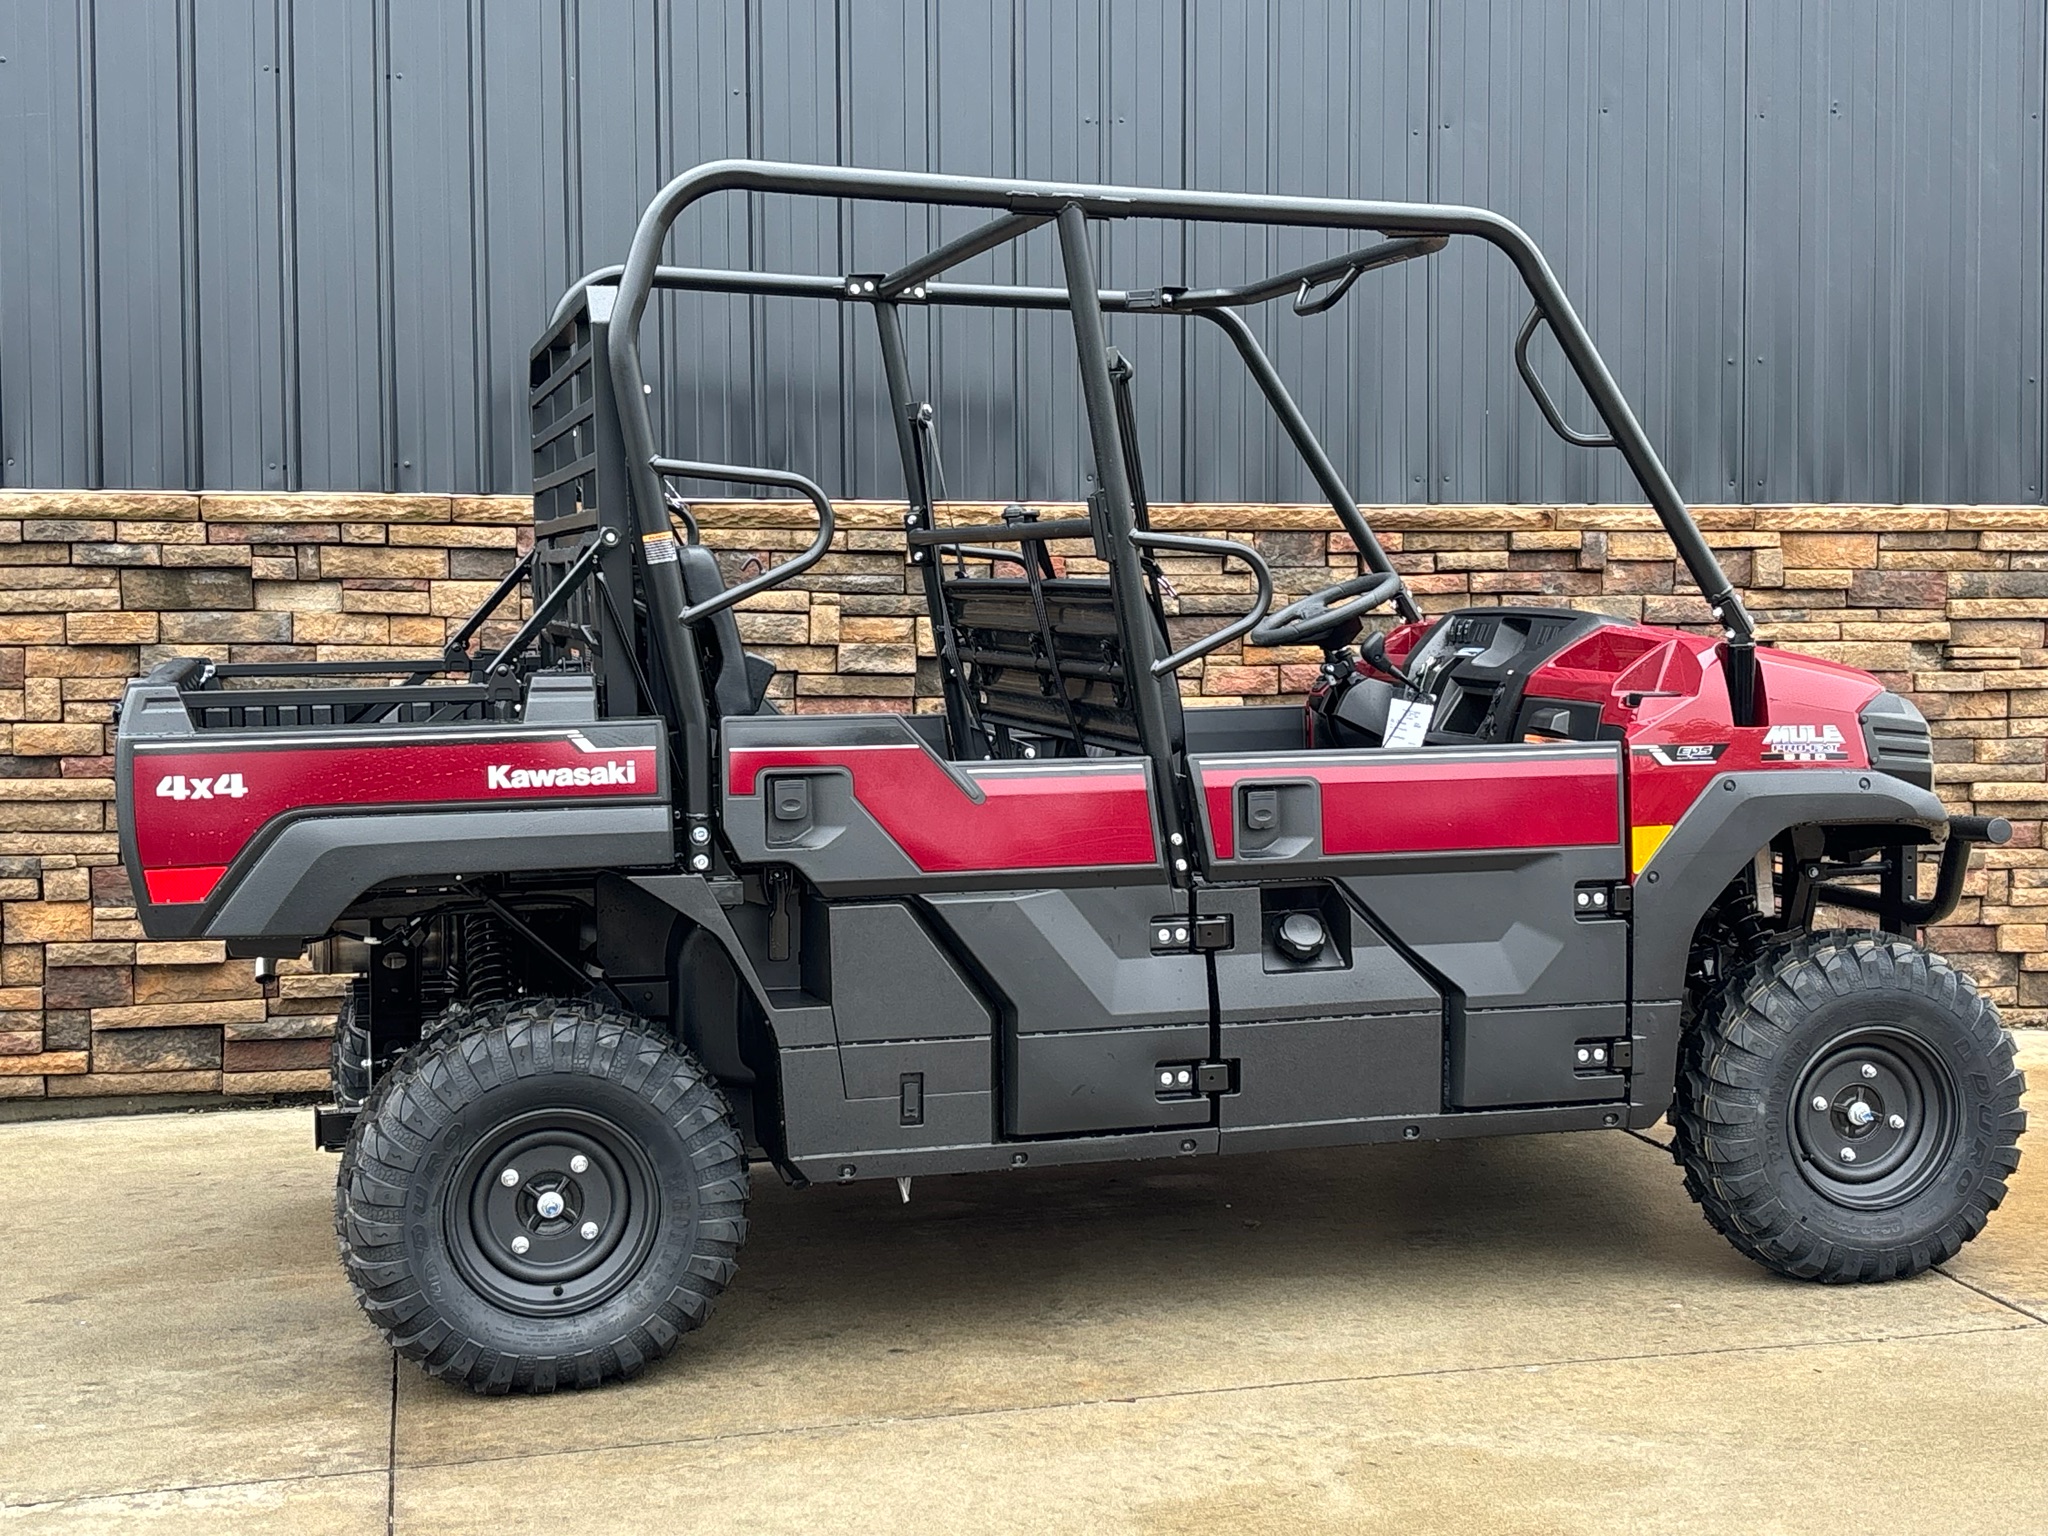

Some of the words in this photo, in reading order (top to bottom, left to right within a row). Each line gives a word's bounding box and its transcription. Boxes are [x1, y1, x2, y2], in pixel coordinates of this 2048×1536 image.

[1761, 725, 1847, 744] MULE
[155, 772, 249, 801] 4x4
[487, 760, 636, 790] Kawasaki
[1955, 1071, 1994, 1197] DURO
[410, 1122, 464, 1251] DURO
